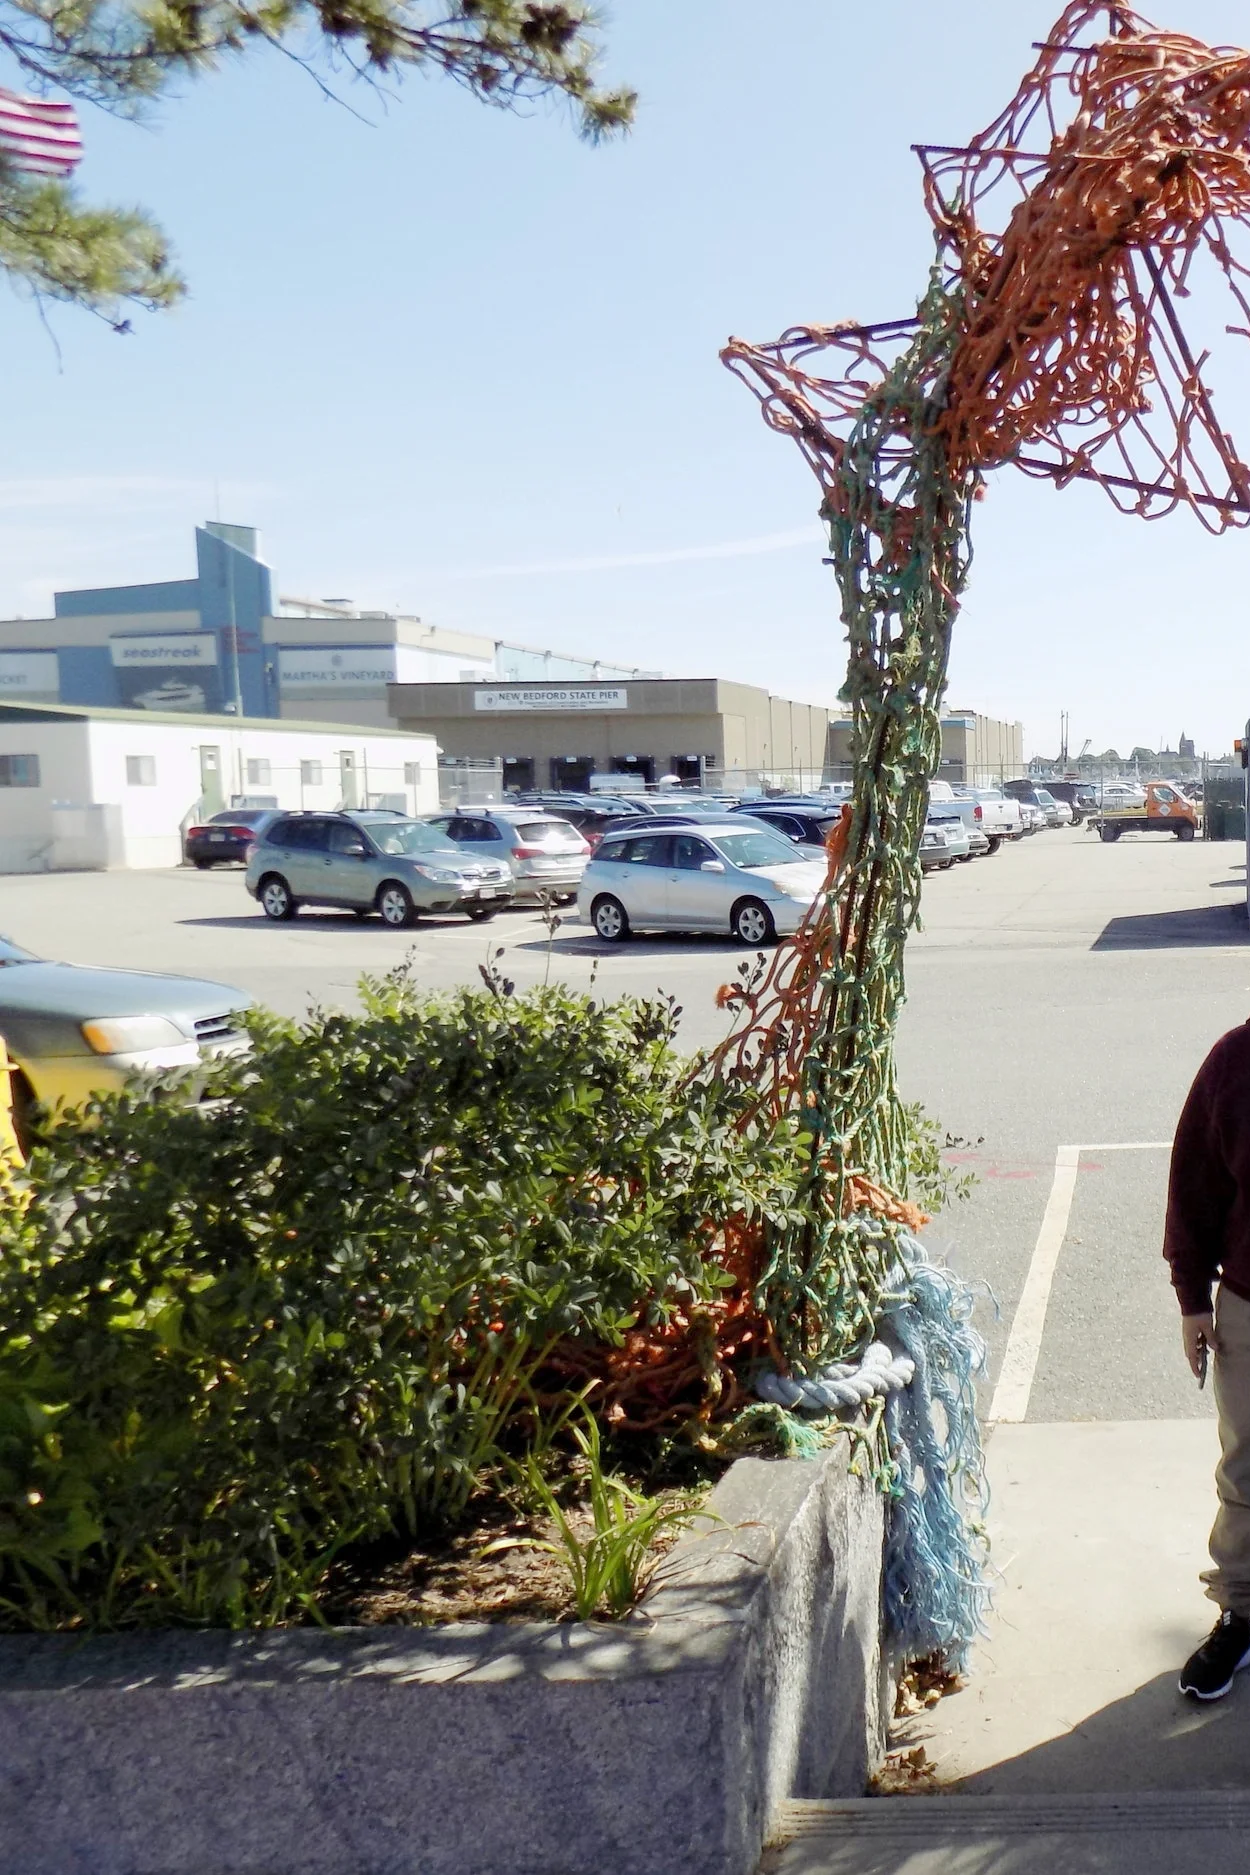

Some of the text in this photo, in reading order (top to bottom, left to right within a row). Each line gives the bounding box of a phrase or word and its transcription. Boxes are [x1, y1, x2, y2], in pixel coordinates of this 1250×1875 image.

[123, 645, 201, 658] seastreak
[0, 674, 27, 684] CKET
[282, 670, 395, 680] MARTHA'S VINEYARD
[499, 691, 619, 701] NEW BEDFORD STATE PIER
